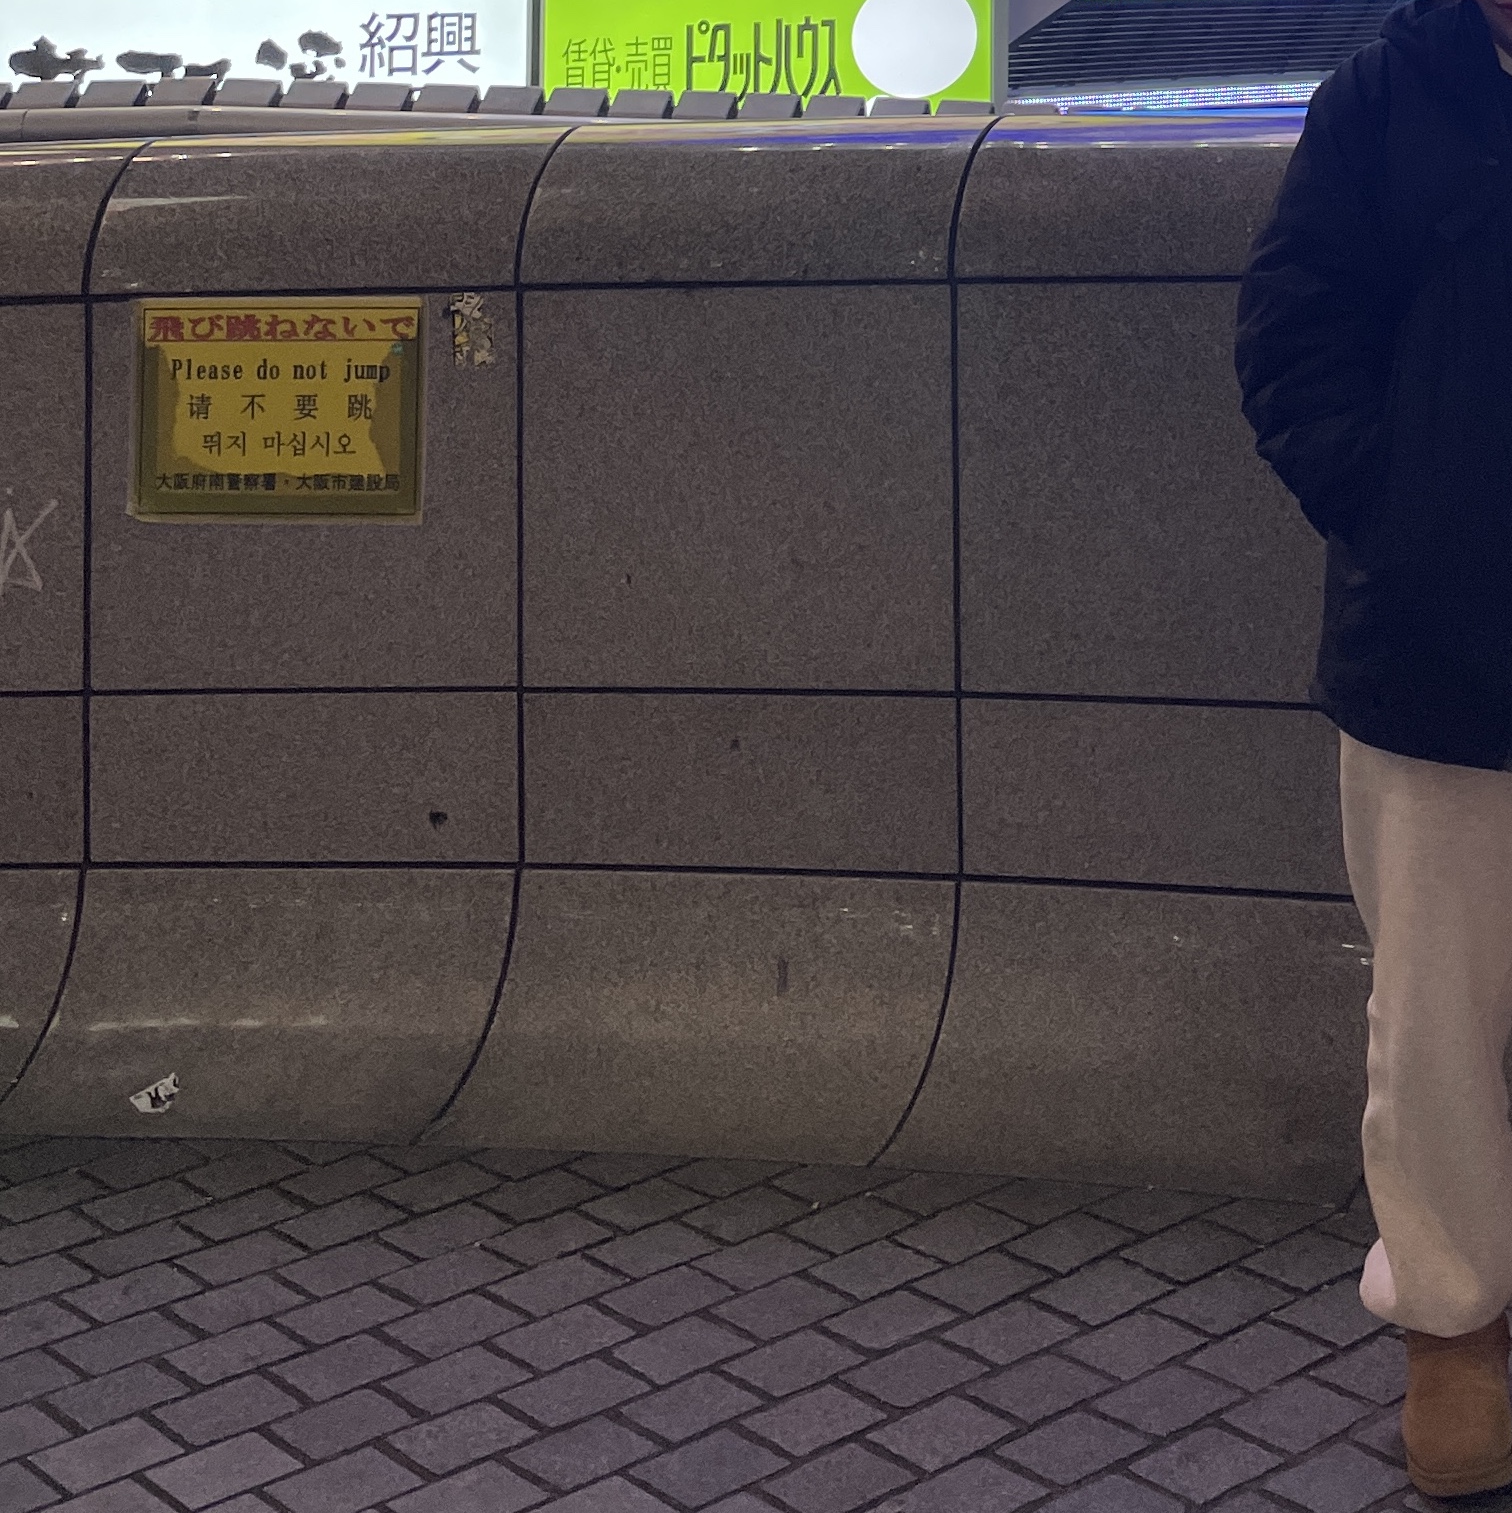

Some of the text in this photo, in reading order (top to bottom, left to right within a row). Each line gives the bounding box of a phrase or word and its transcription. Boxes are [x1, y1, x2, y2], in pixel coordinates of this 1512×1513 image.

[358, 11, 482, 78] 紹興
[685, 14, 843, 101] ピタットハウス
[149, 313, 417, 342] 飛び跳ねないで
[171, 358, 391, 384] Please do not jump
[261, 429, 358, 458] 마십시오
